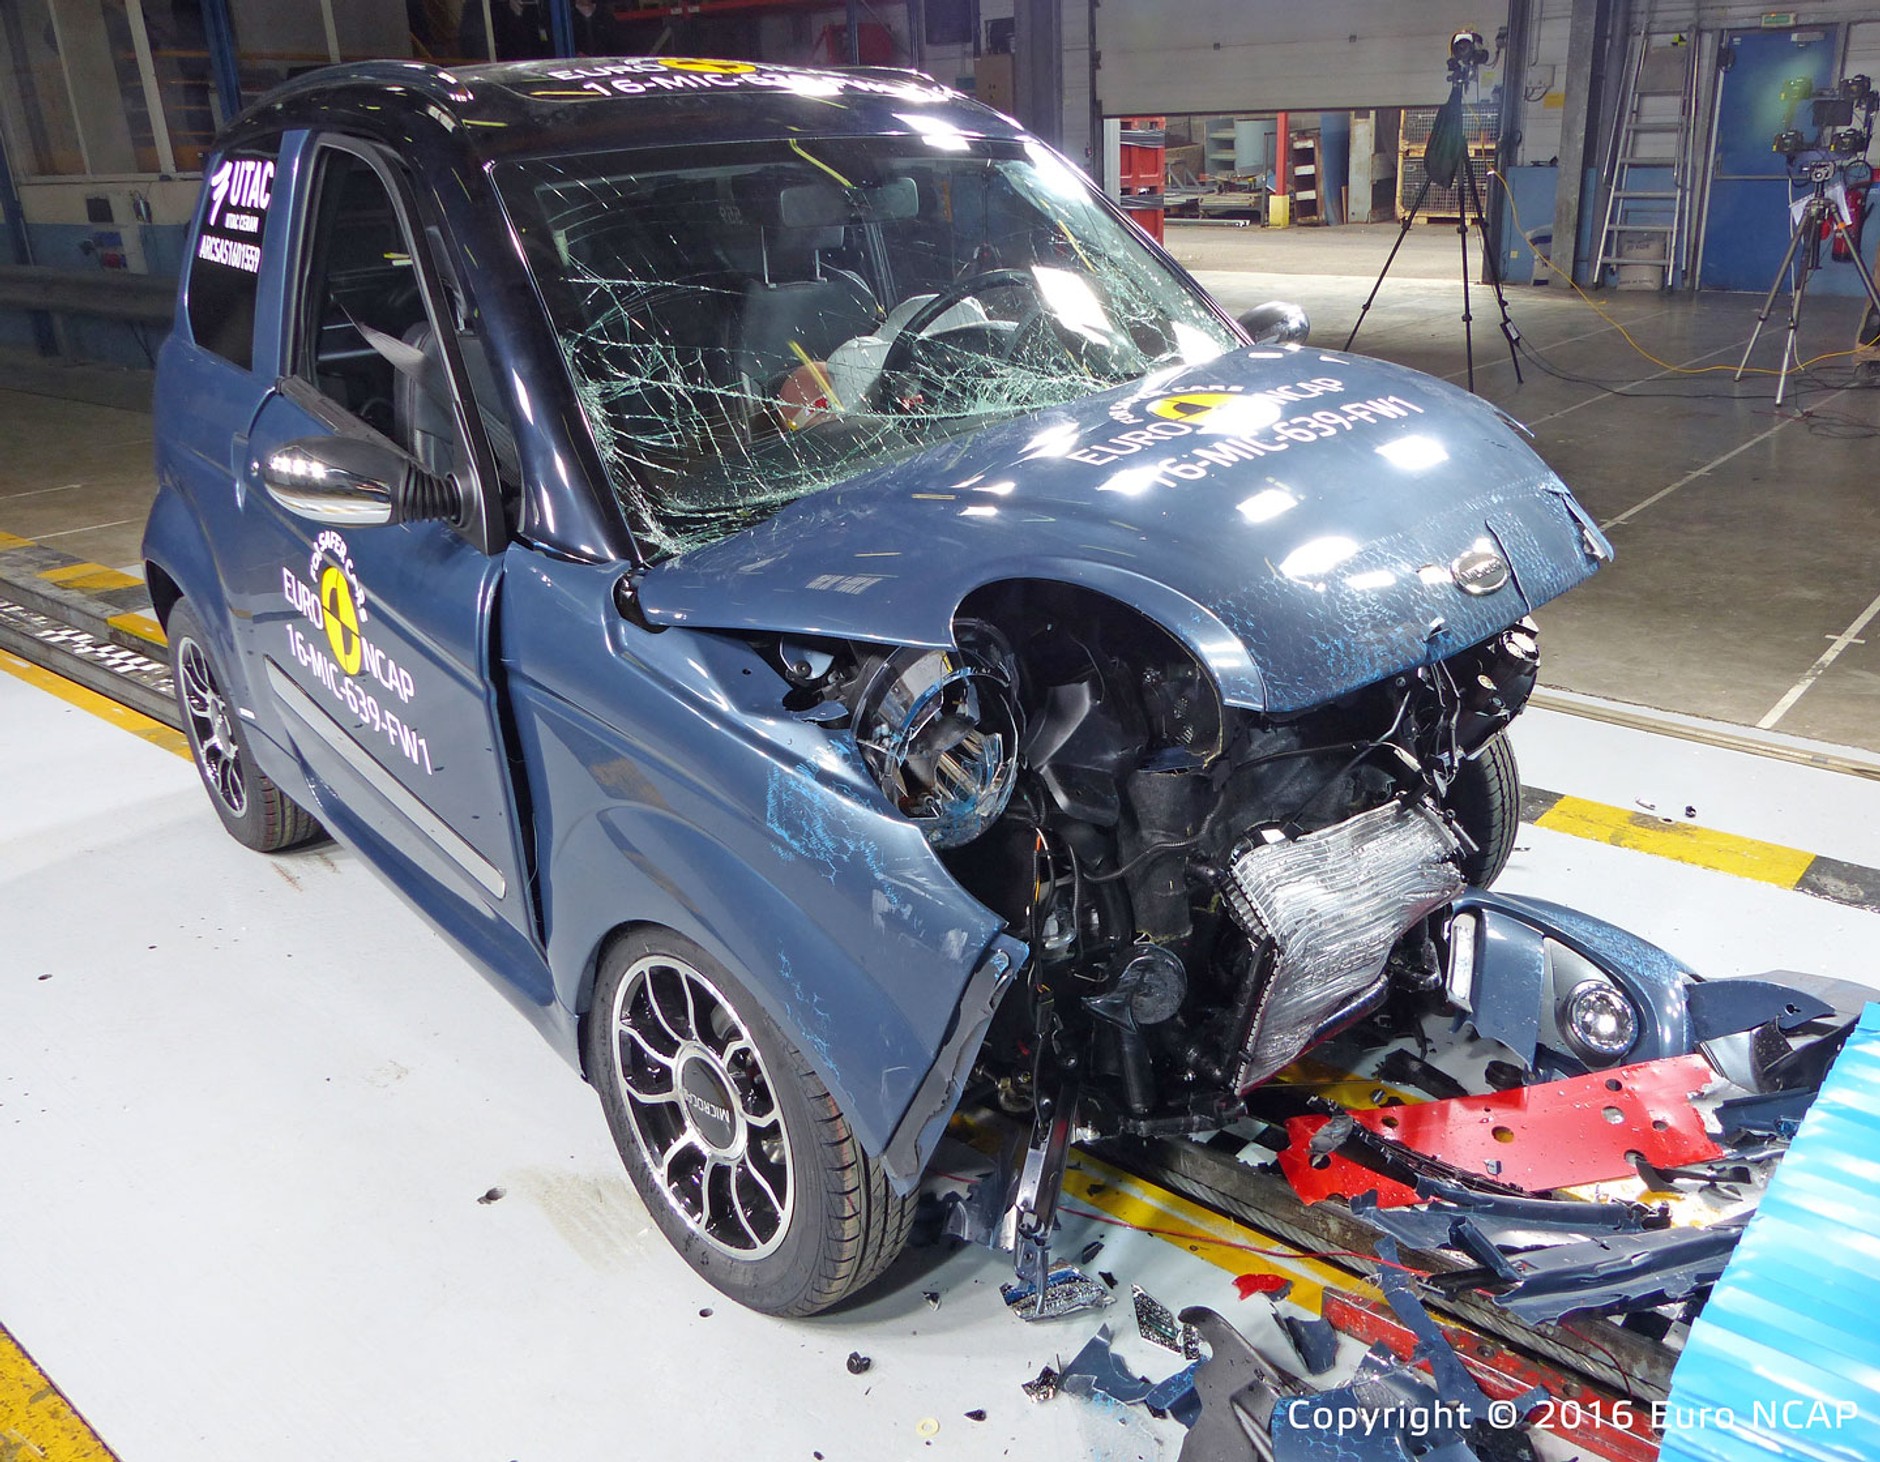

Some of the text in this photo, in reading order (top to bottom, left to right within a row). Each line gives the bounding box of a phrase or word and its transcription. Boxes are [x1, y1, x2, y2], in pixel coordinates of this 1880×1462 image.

[228, 160, 275, 210] UTAC
[1066, 377, 1345, 466] EURO NCAP
[282, 566, 415, 704] EURO NCAP
[285, 623, 433, 776] 16-MIC-639-FW1
